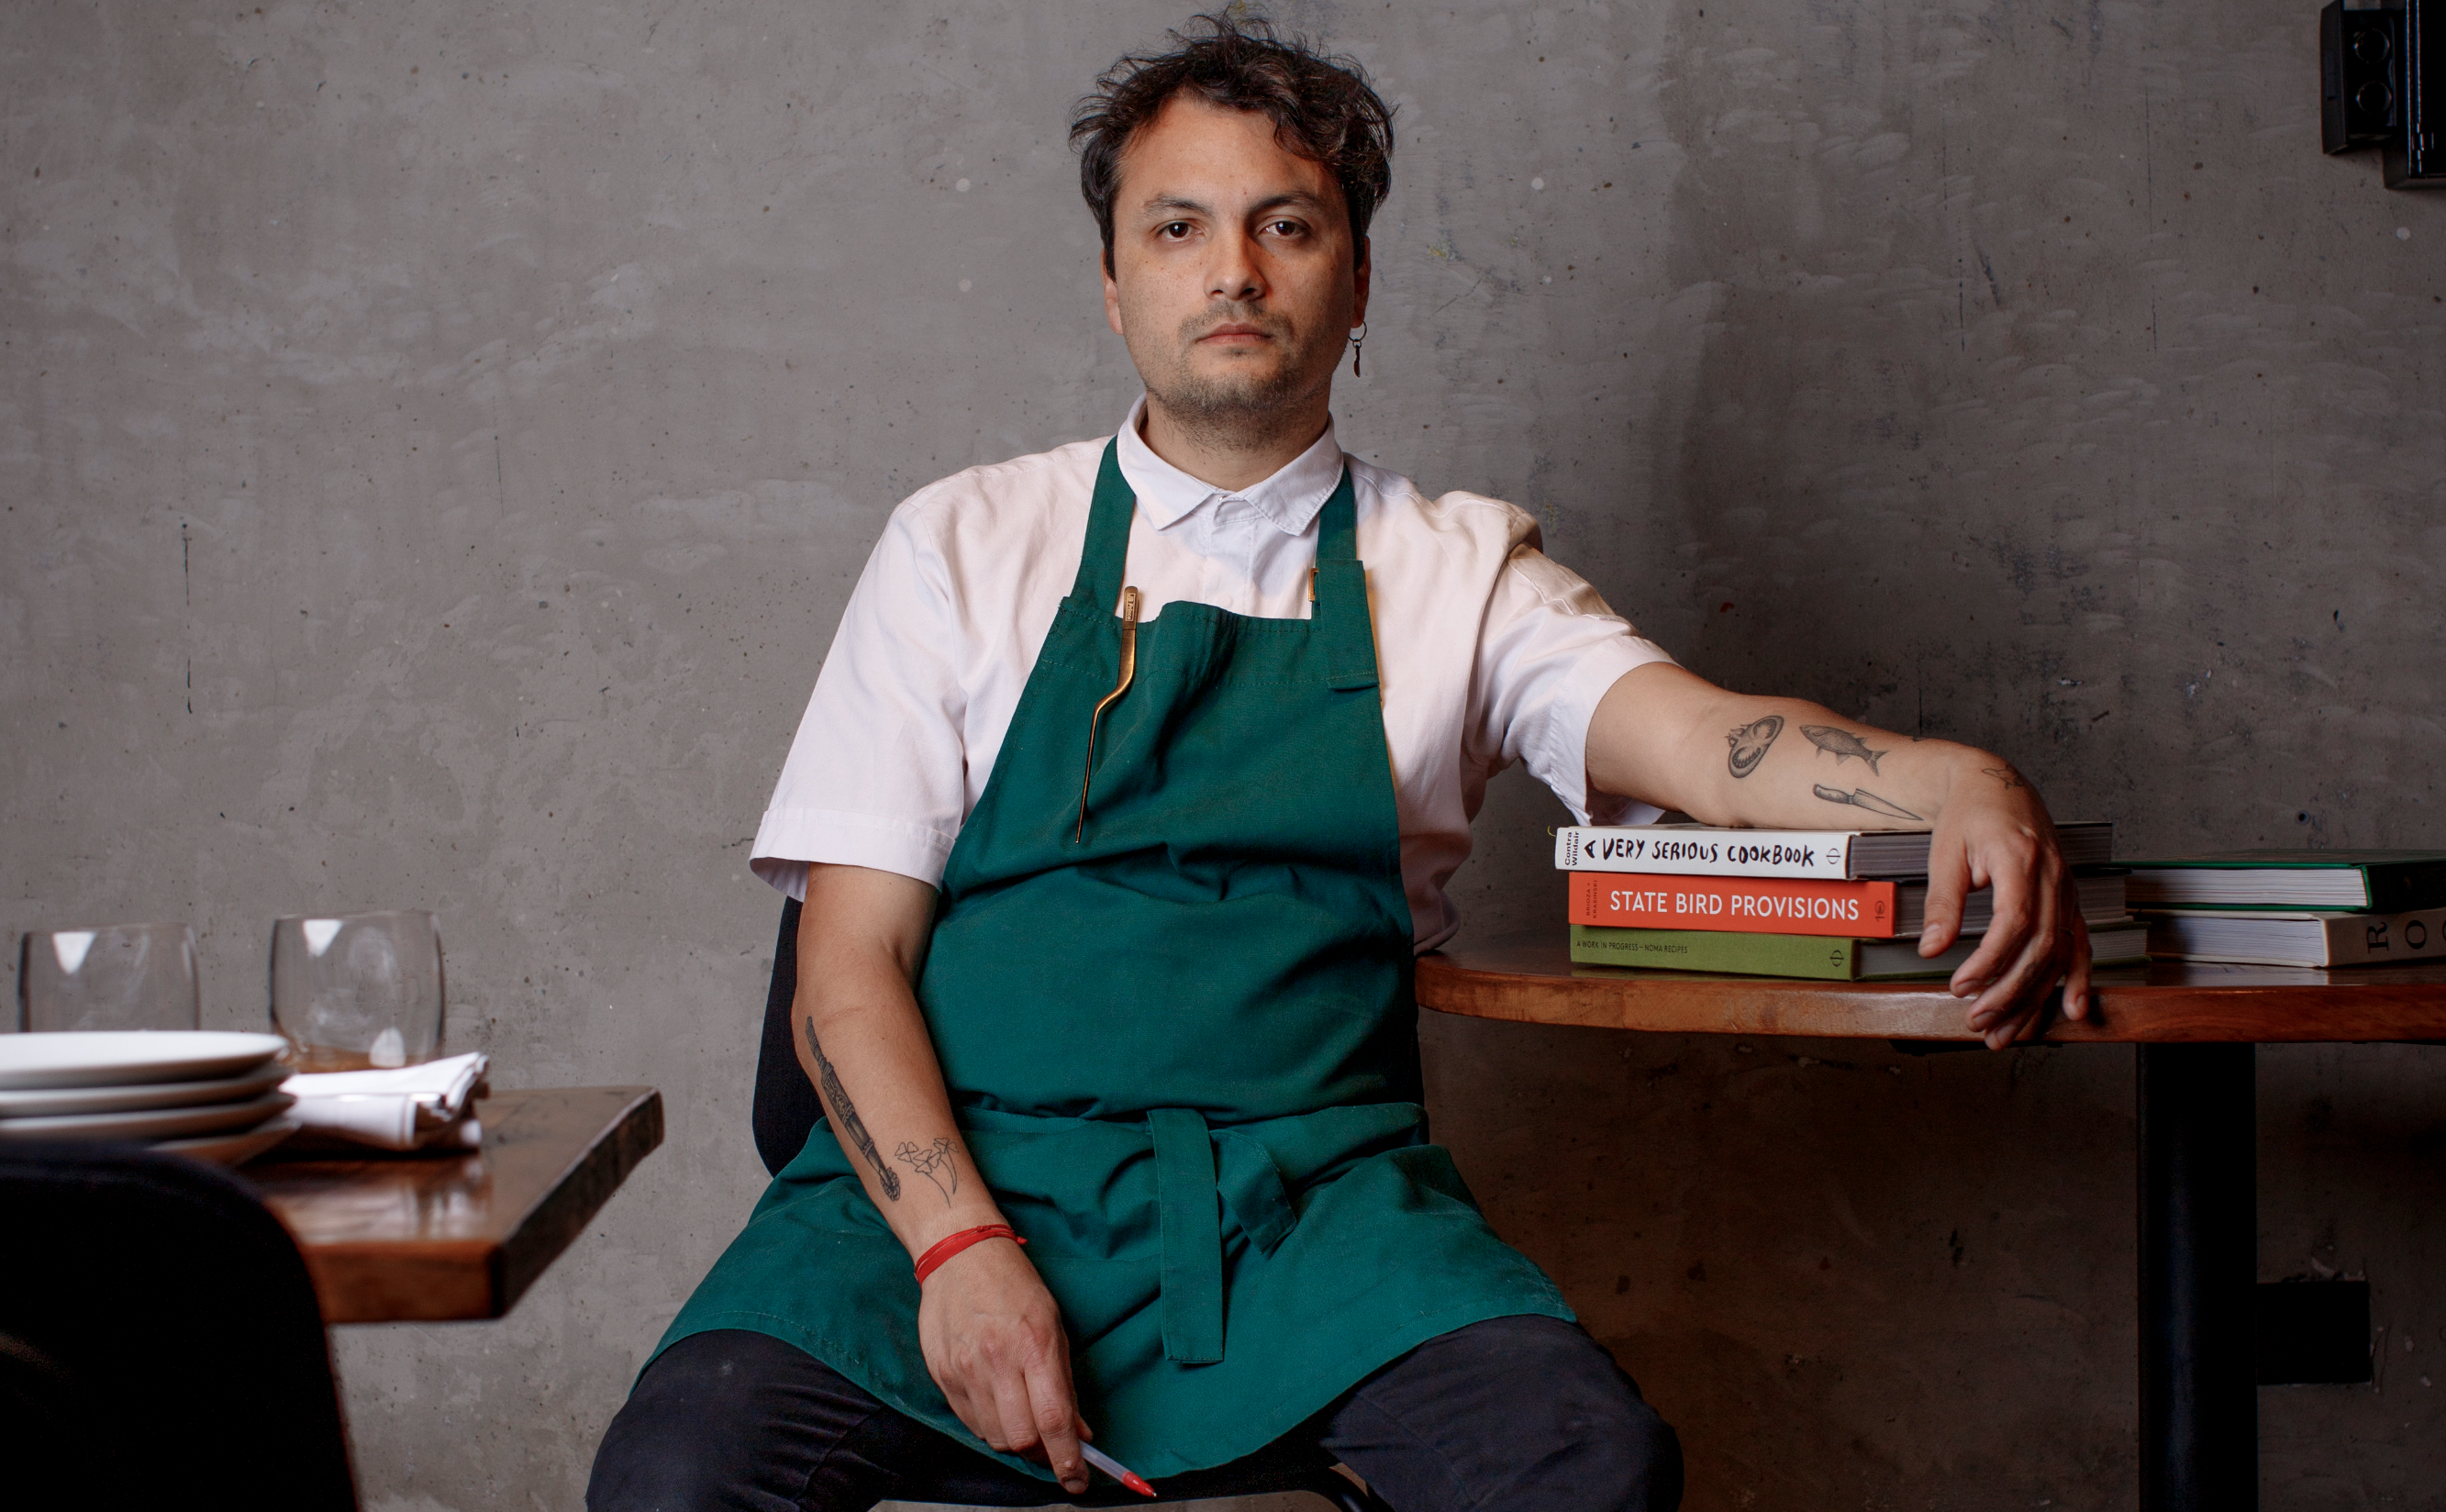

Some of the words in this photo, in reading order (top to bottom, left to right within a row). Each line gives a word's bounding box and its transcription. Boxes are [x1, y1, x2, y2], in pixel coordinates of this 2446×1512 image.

[1564, 831, 1573, 866] Contra
[1572, 830, 1580, 867] Wildair
[1584, 839, 1596, 860] A
[1602, 838, 1646, 861] VERY
[1651, 840, 1718, 863] SERIOUS
[1727, 844, 1815, 867] COOKBOOK
[1609, 890, 1668, 913] STATE
[1675, 893, 1723, 915] BIRD
[1730, 895, 1860, 920] PROVISIONS
[1582, 940, 1599, 949] WORK
[1608, 942, 1639, 951] PROGRESS
[1644, 944, 1662, 952] NOMA
[1663, 945, 1688, 953] RECIPES
